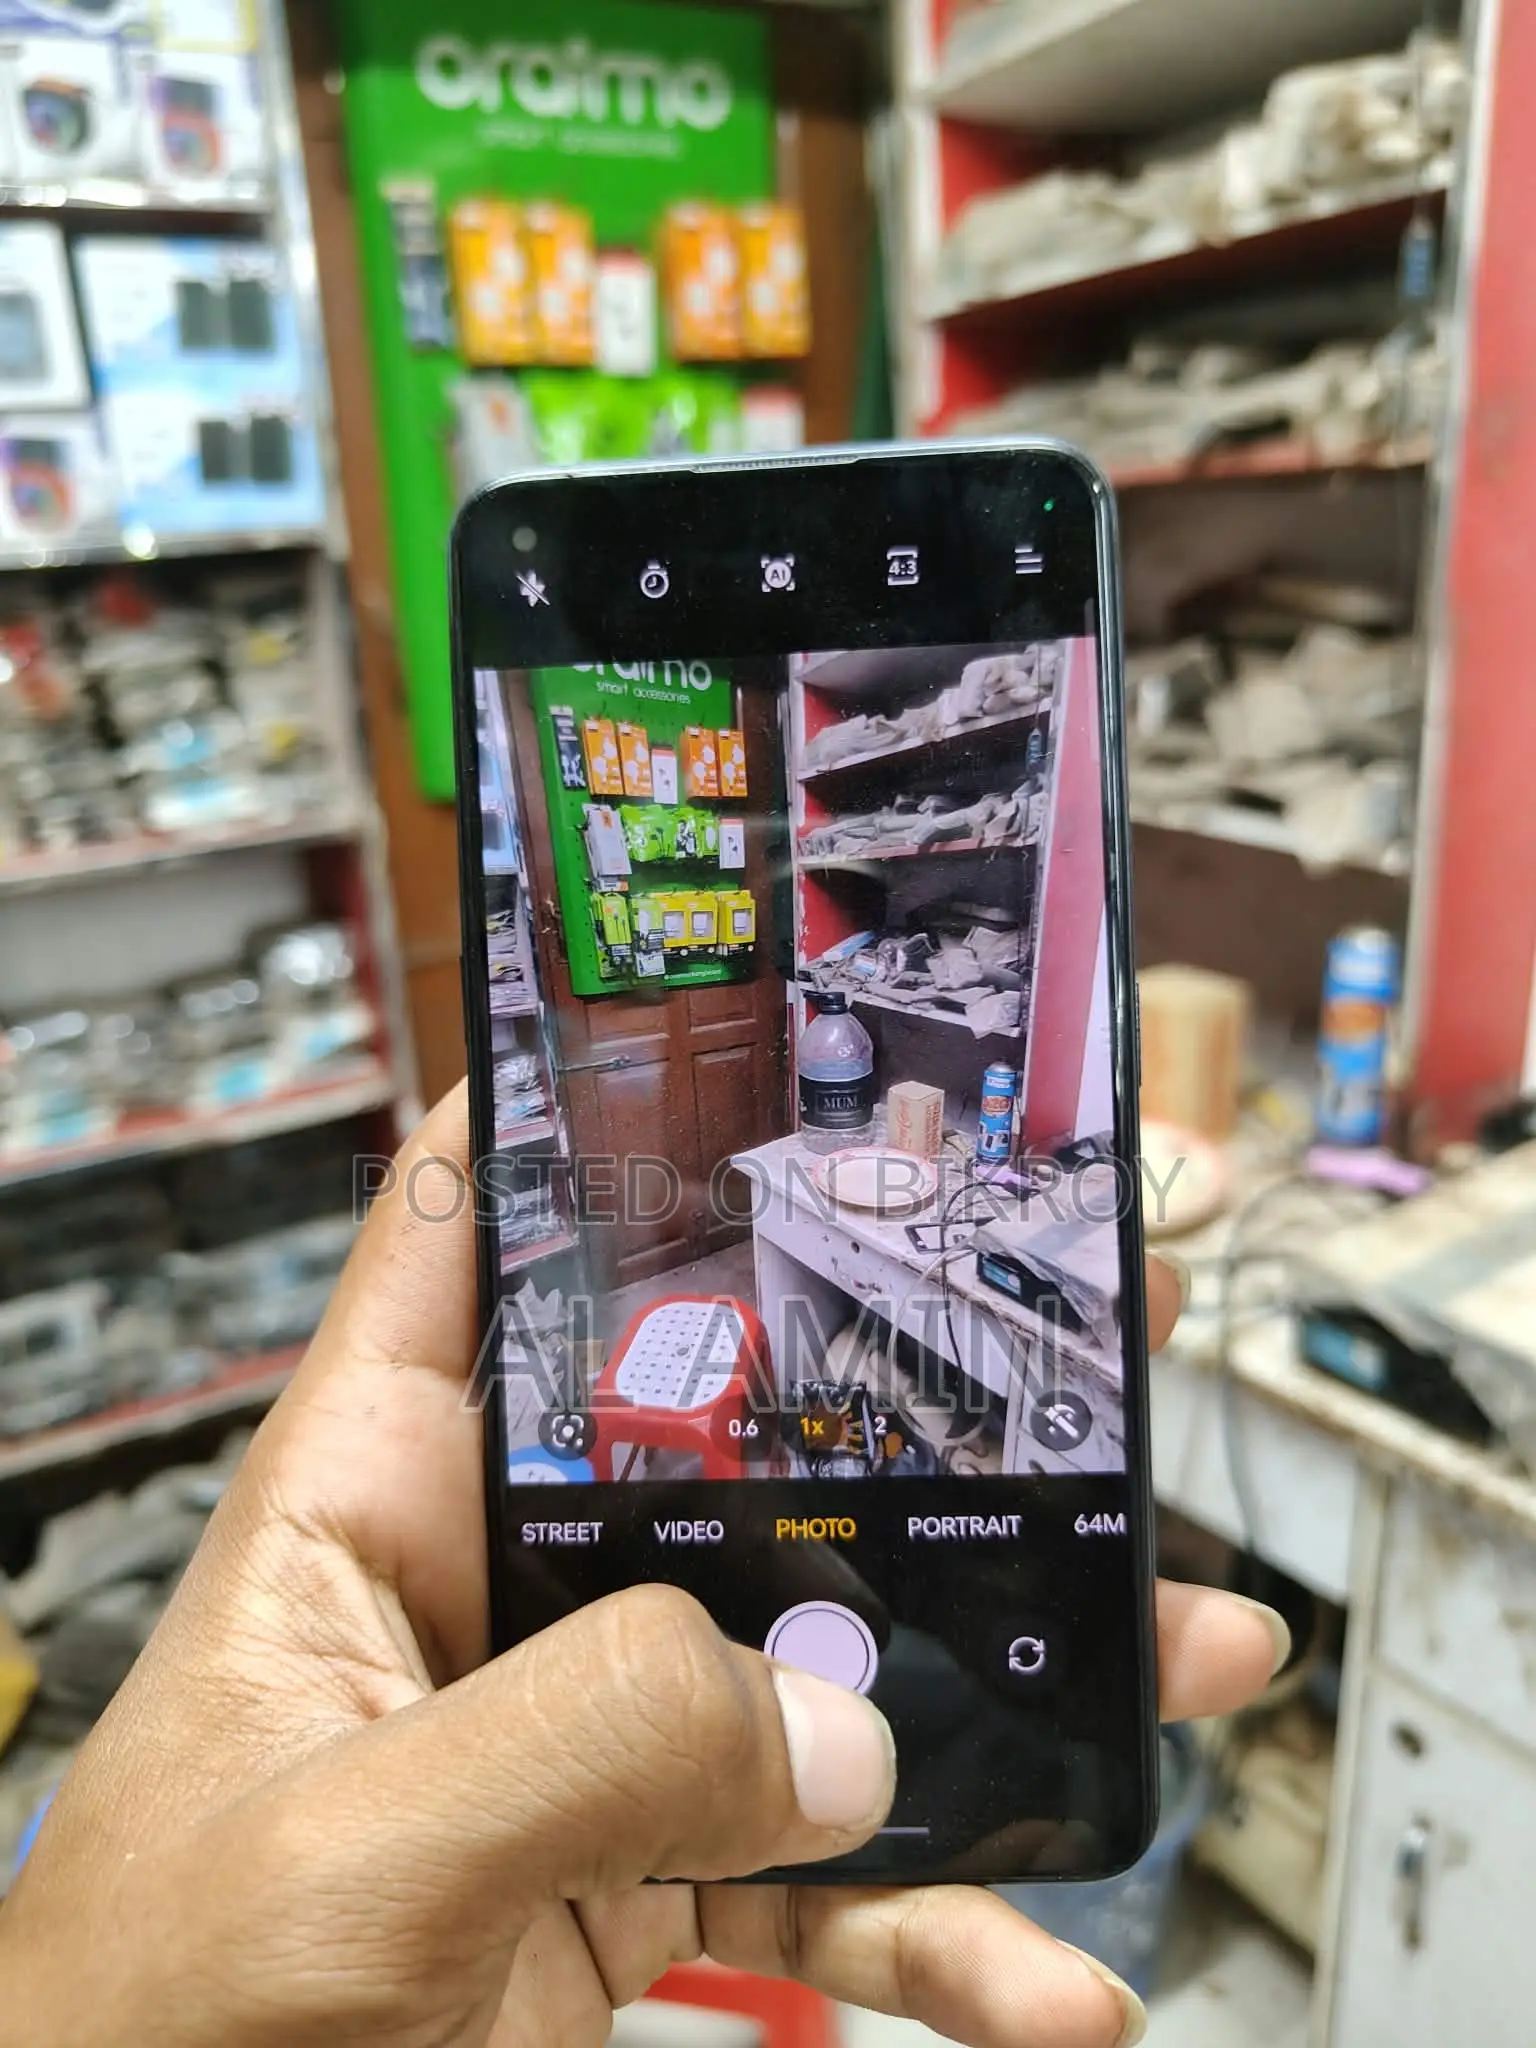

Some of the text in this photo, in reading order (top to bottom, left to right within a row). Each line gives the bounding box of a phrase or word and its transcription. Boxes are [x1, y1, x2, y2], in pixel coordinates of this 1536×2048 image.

[416, 36, 733, 131] oraimo
[888, 560, 917, 575] 4:3
[596, 680, 628, 696] smart
[824, 1096, 858, 1110] MUM
[727, 1418, 758, 1437] 0.6
[800, 1416, 824, 1435] 1x
[873, 1416, 888, 1434] 2
[521, 1521, 602, 1545] STREET
[654, 1519, 724, 1543] VIDEO
[775, 1517, 857, 1541] PHOTO
[907, 1514, 1022, 1541] PORTRAIT
[1073, 1512, 1127, 1536] 64M
